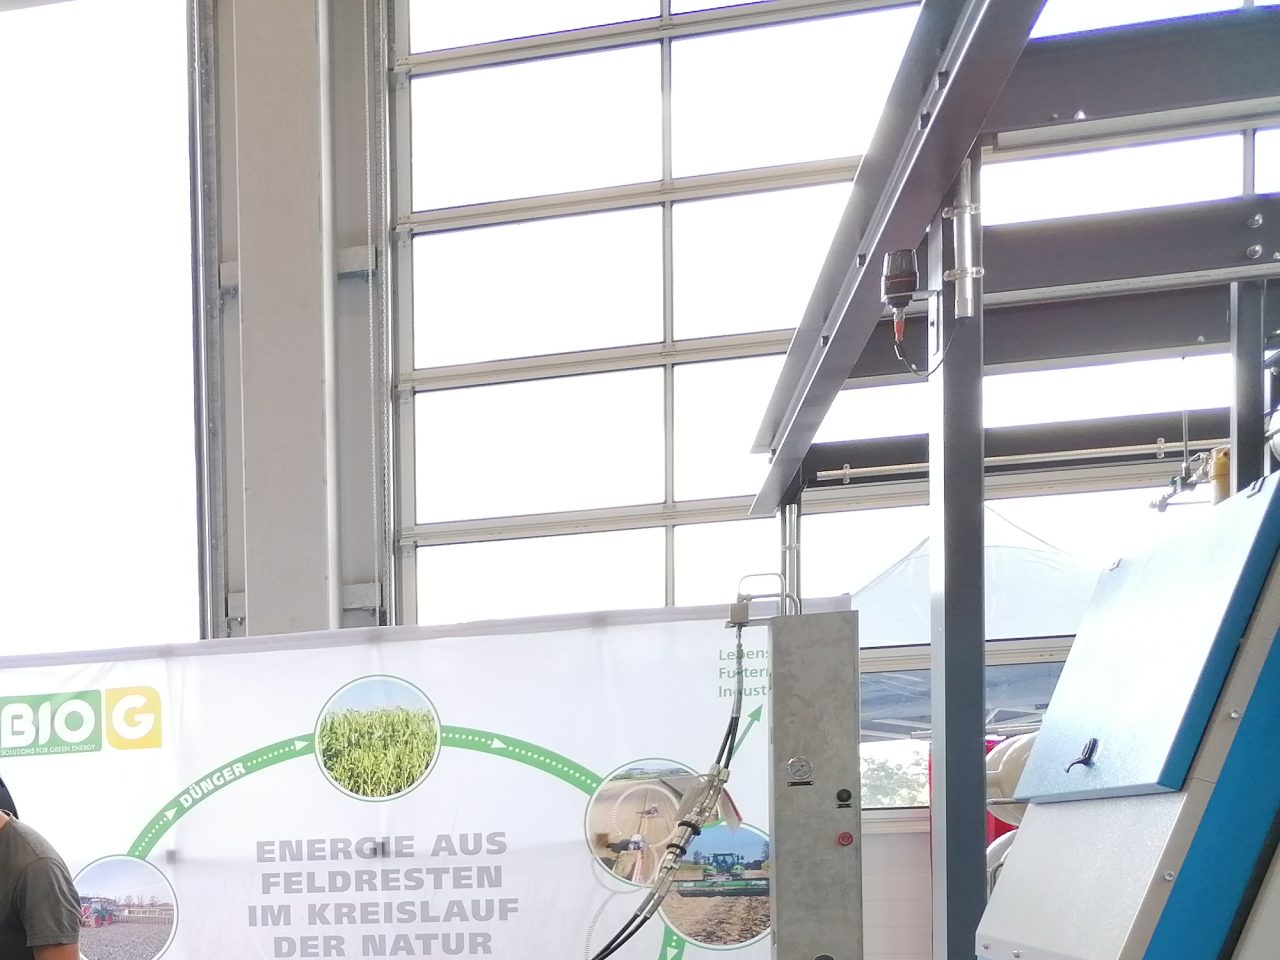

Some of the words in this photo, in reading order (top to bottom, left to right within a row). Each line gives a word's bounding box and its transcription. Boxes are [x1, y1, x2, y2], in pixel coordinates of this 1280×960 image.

[719, 667, 769, 679] Futer
[718, 685, 768, 698] Inust
[1, 747, 35, 757] SOLUTIONS
[36, 746, 49, 754] FOR
[49, 745, 71, 754] GREEN
[71, 743, 96, 752] ENERGY
[178, 762, 247, 809] DÜNGER
[256, 834, 415, 863] ENERGIE
[430, 831, 508, 857] AUS
[261, 865, 503, 895] FELDRESTEN
[248, 904, 292, 927] IM
[307, 898, 519, 926] KREISLAUF
[273, 935, 346, 959] DER
[361, 932, 494, 957] NATUR
